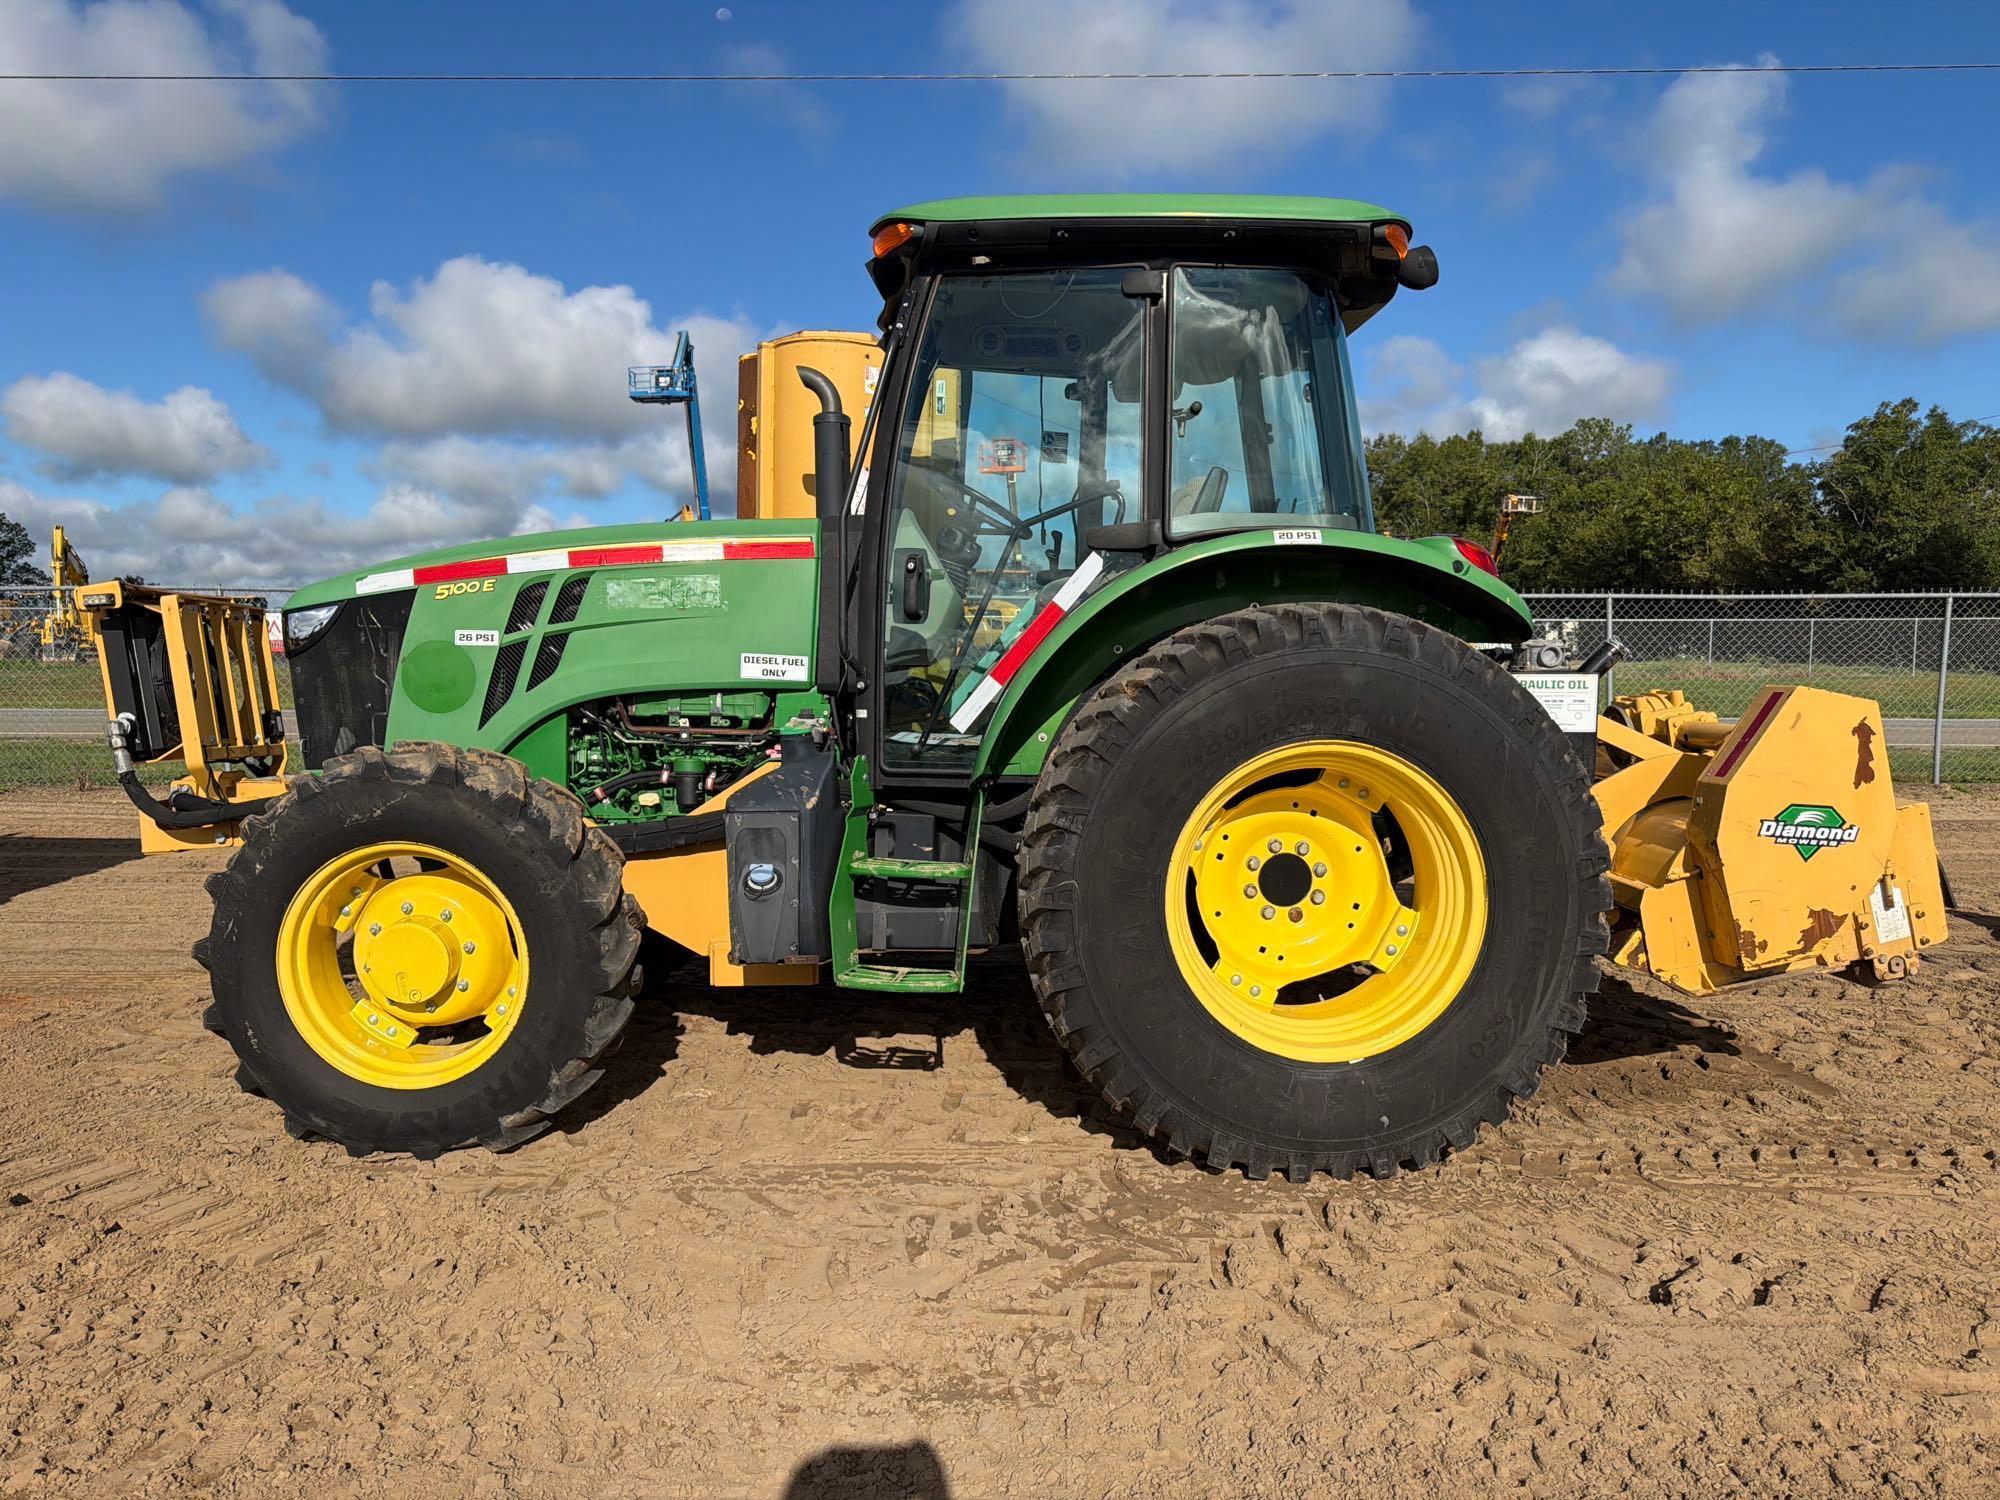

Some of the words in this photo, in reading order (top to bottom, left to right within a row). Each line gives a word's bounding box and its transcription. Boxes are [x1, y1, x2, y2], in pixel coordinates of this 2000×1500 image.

[1278, 532, 1293, 540] 20
[1297, 532, 1318, 540] PSI
[459, 634, 473, 642] 26
[476, 634, 495, 642] PSI
[744, 656, 779, 665] DIESEL
[782, 658, 805, 666] FUEL
[762, 669, 787, 677] ONLY
[1520, 680, 1565, 689] RAULIC
[1568, 680, 1589, 689] OIL
[1759, 820, 1859, 840] Diamond
[1777, 838, 1837, 847] MOWERS
